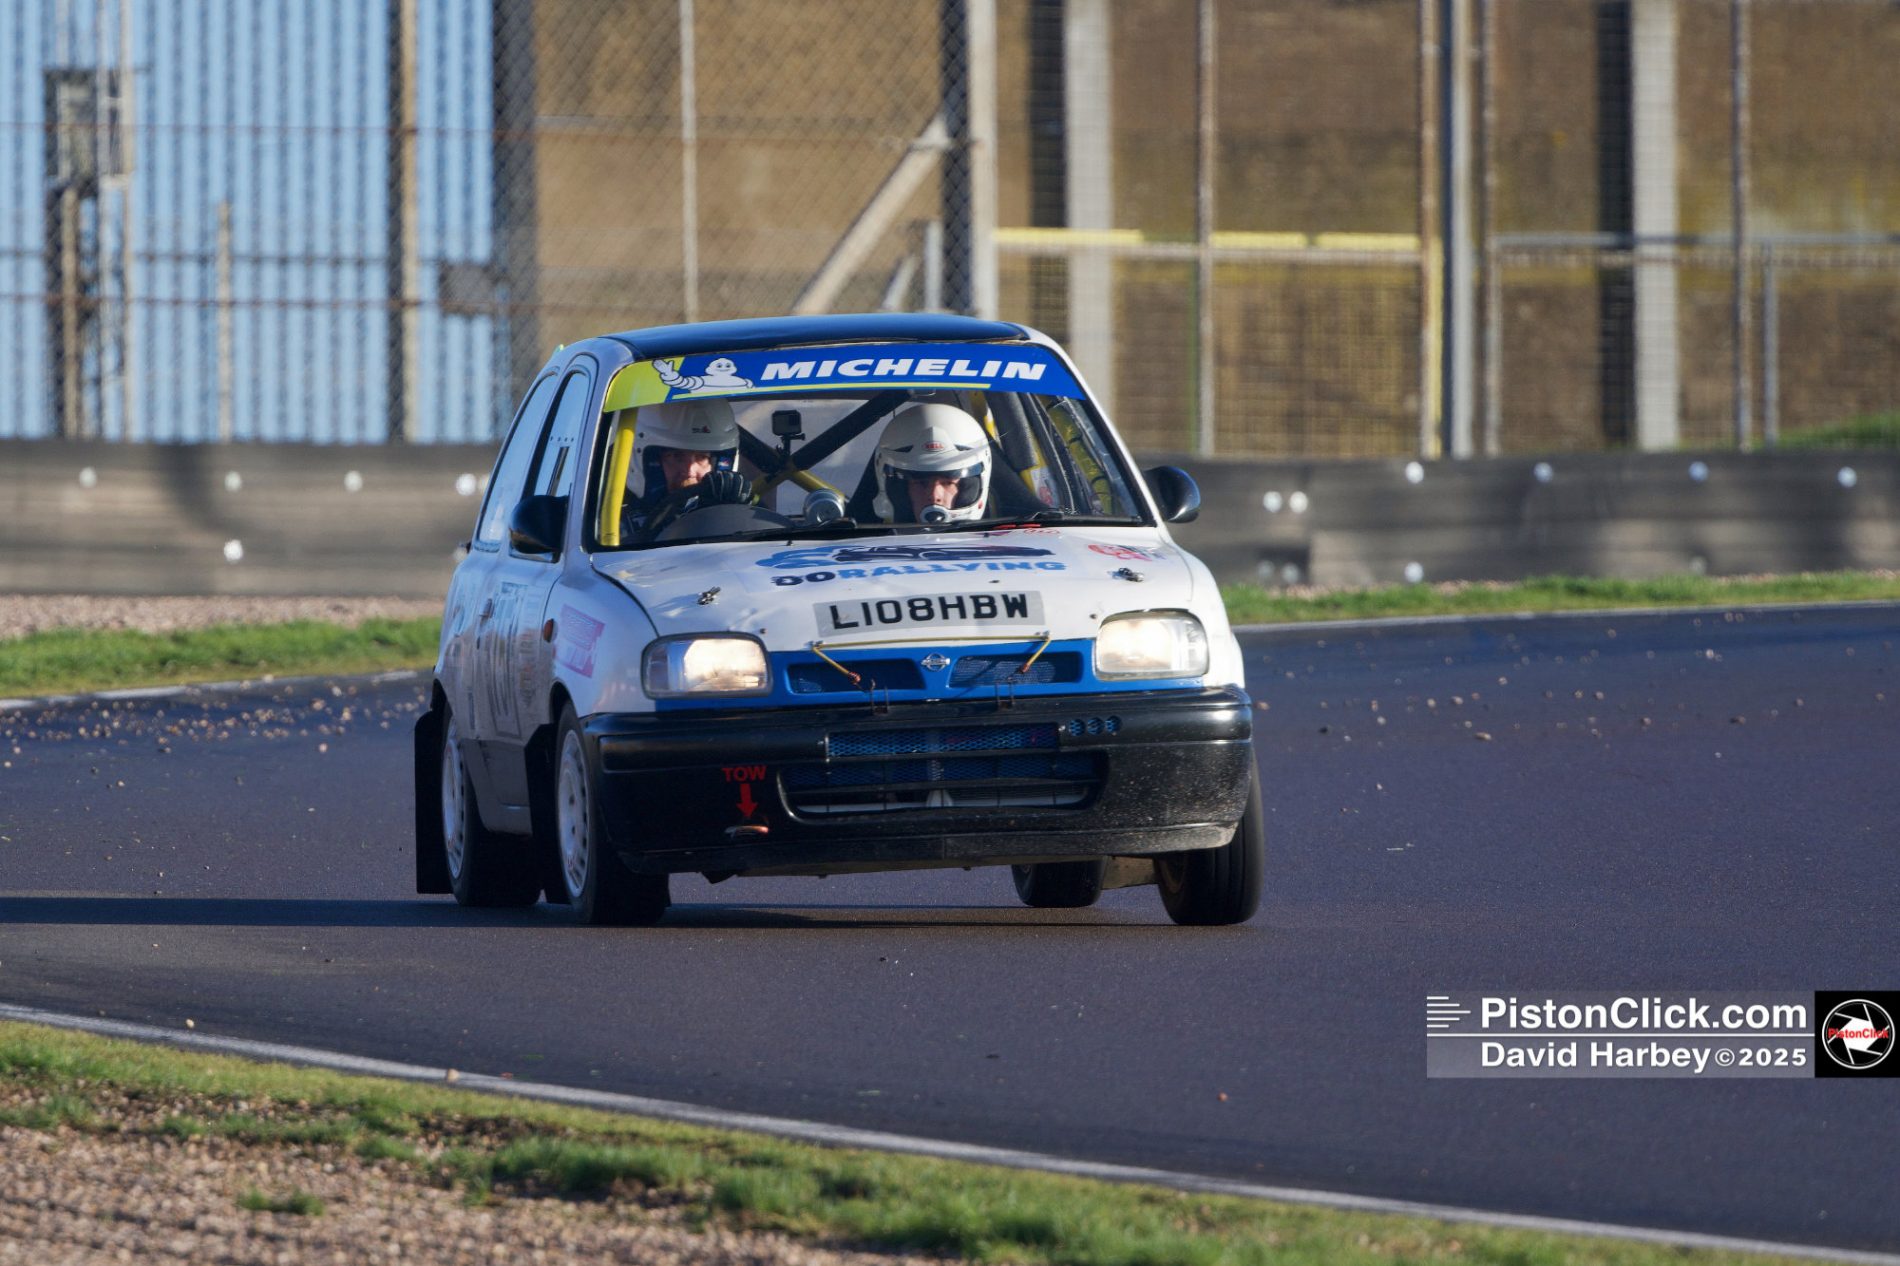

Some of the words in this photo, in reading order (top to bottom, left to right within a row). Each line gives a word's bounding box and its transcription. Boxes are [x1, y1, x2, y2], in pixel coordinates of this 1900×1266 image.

[760, 358, 1047, 382] MICHELIN
[773, 561, 1067, 587] DORALLYING
[829, 593, 1029, 631] L108HBW
[721, 765, 768, 783] TOW
